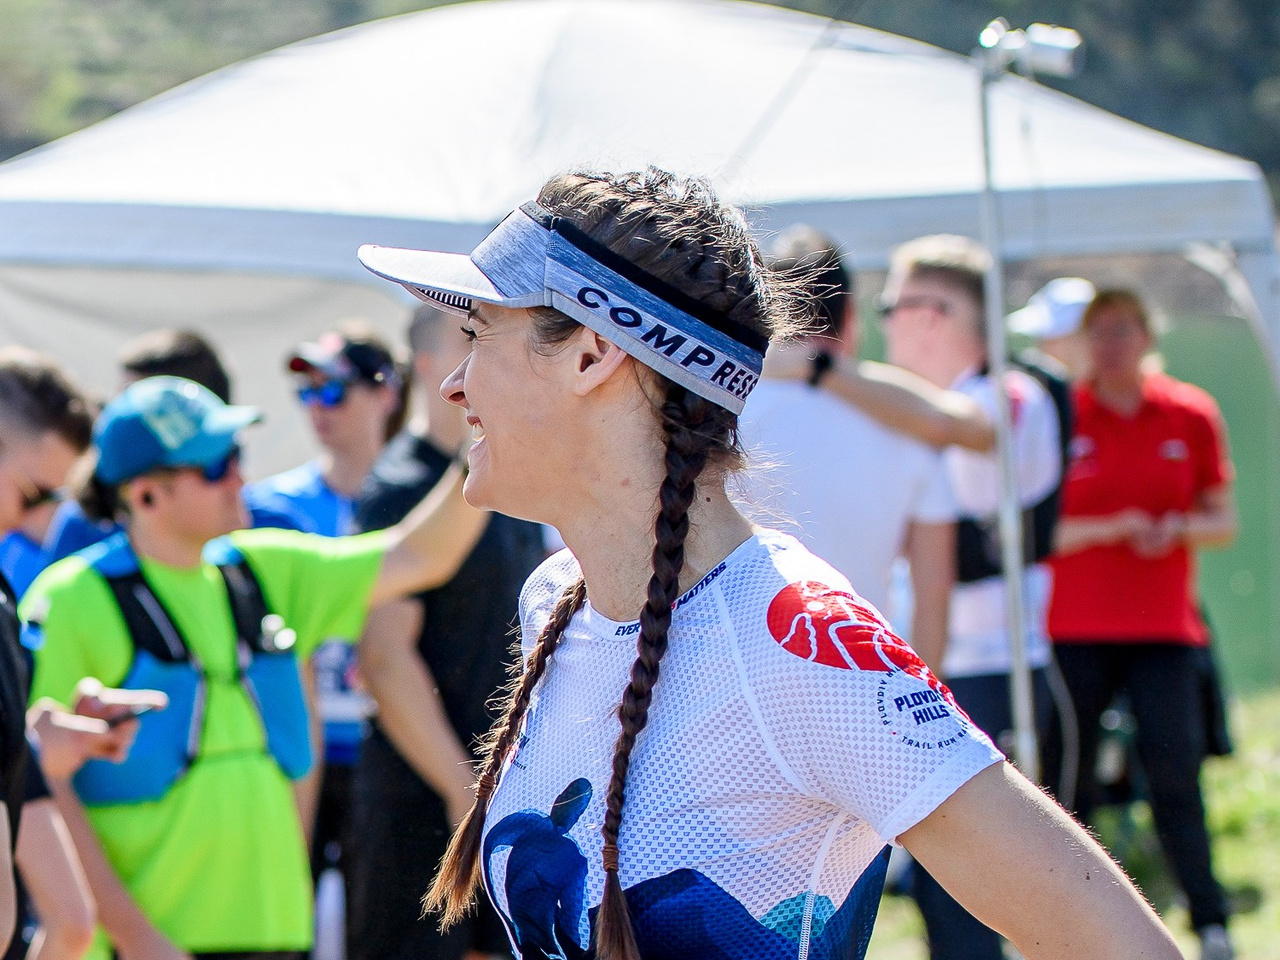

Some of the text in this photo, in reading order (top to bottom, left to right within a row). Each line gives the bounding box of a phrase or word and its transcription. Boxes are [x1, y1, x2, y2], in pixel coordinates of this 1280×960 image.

[676, 562, 727, 610] MATTERS
[912, 704, 951, 726] HILLS
[901, 736, 932, 750] TRAIL
[937, 737, 957, 748] RUN
